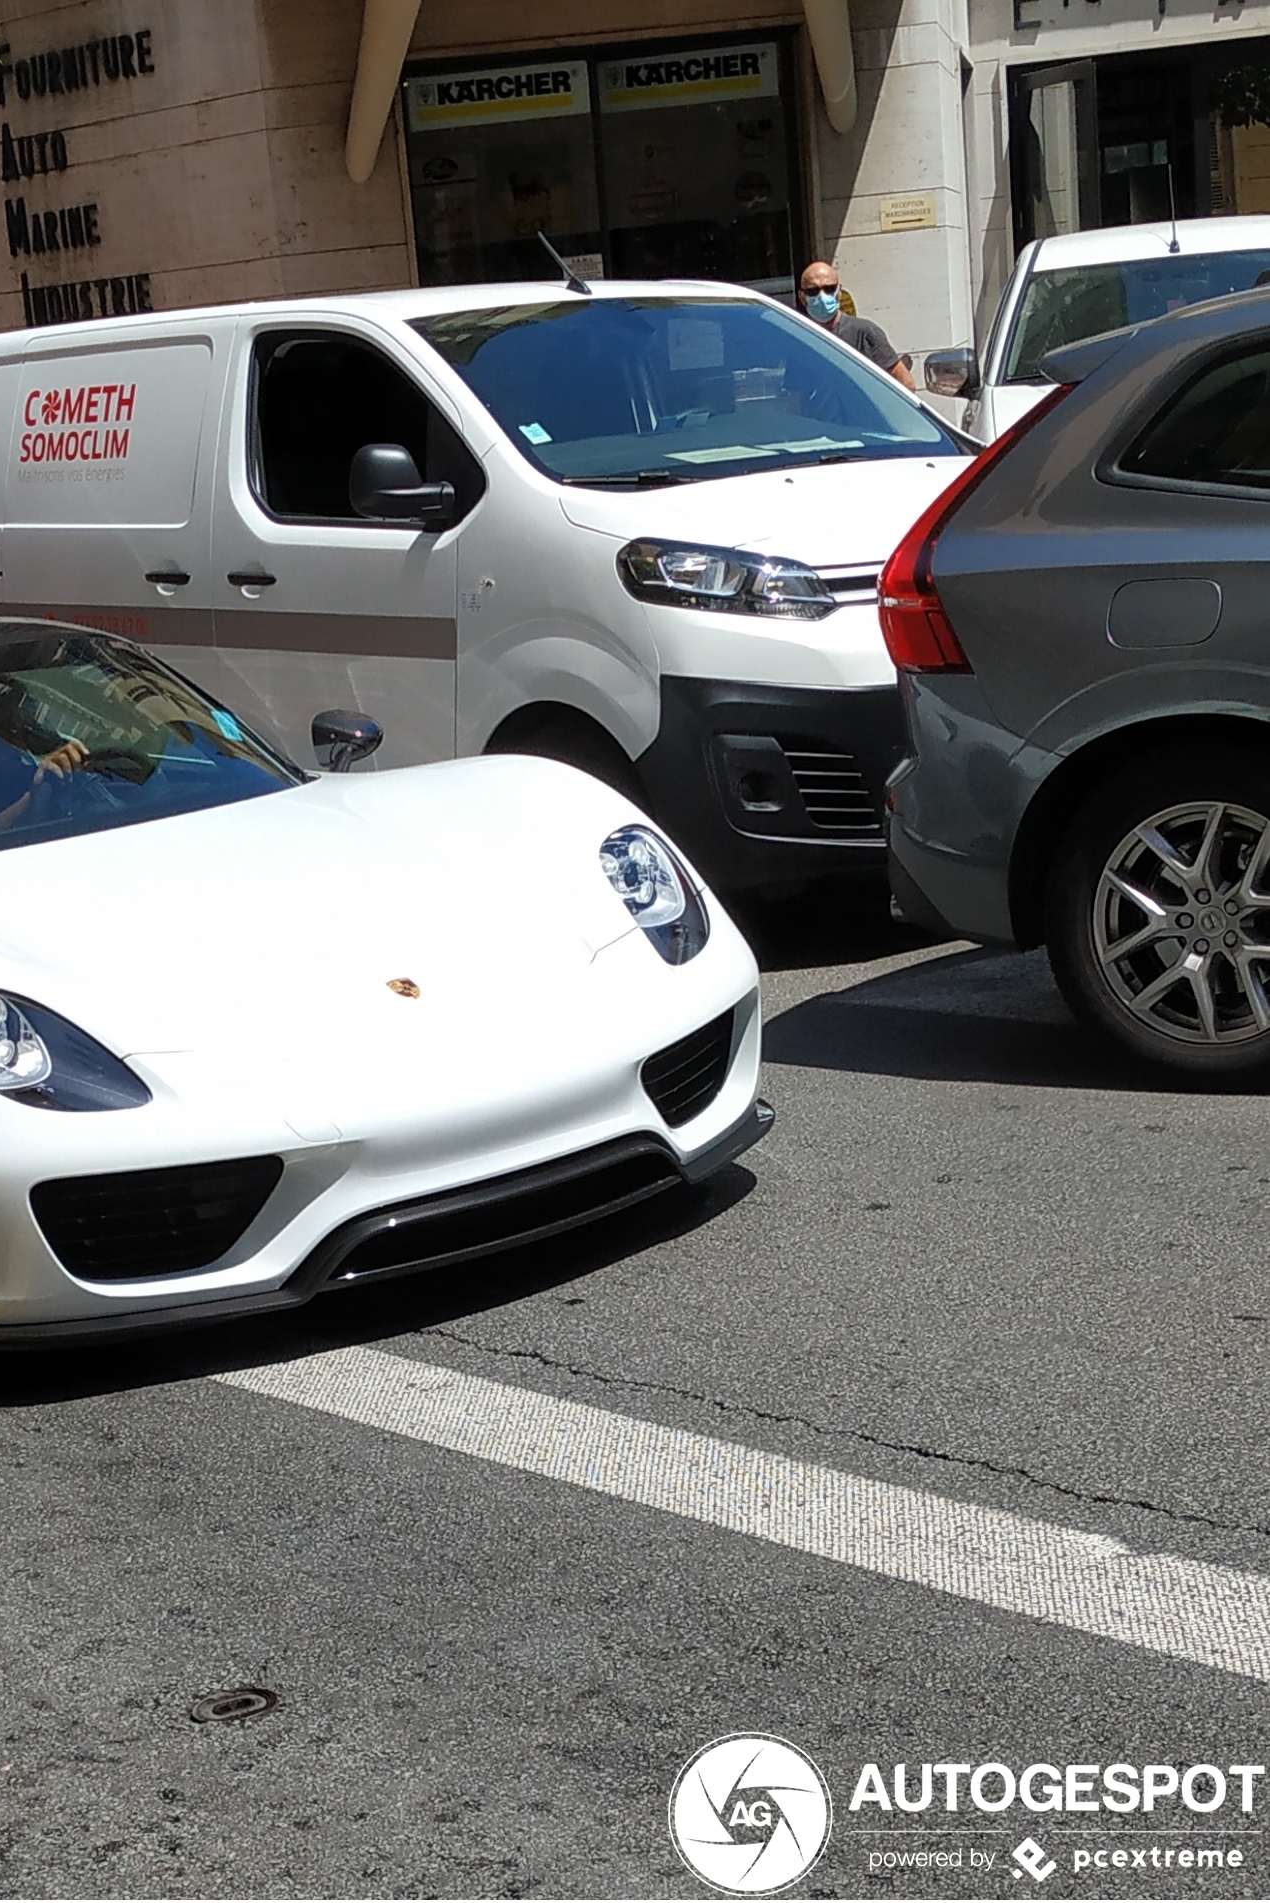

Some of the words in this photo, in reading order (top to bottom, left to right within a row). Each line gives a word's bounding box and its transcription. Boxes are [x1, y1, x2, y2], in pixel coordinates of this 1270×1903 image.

[436, 70, 572, 105] KÄRCHER
[625, 53, 761, 88] KÄRCHER
[2, 123, 67, 182] AUTO
[5, 197, 101, 258] MARINE
[21, 272, 154, 328] INDUSTRIE
[19, 428, 130, 463] SOMOCLIM
